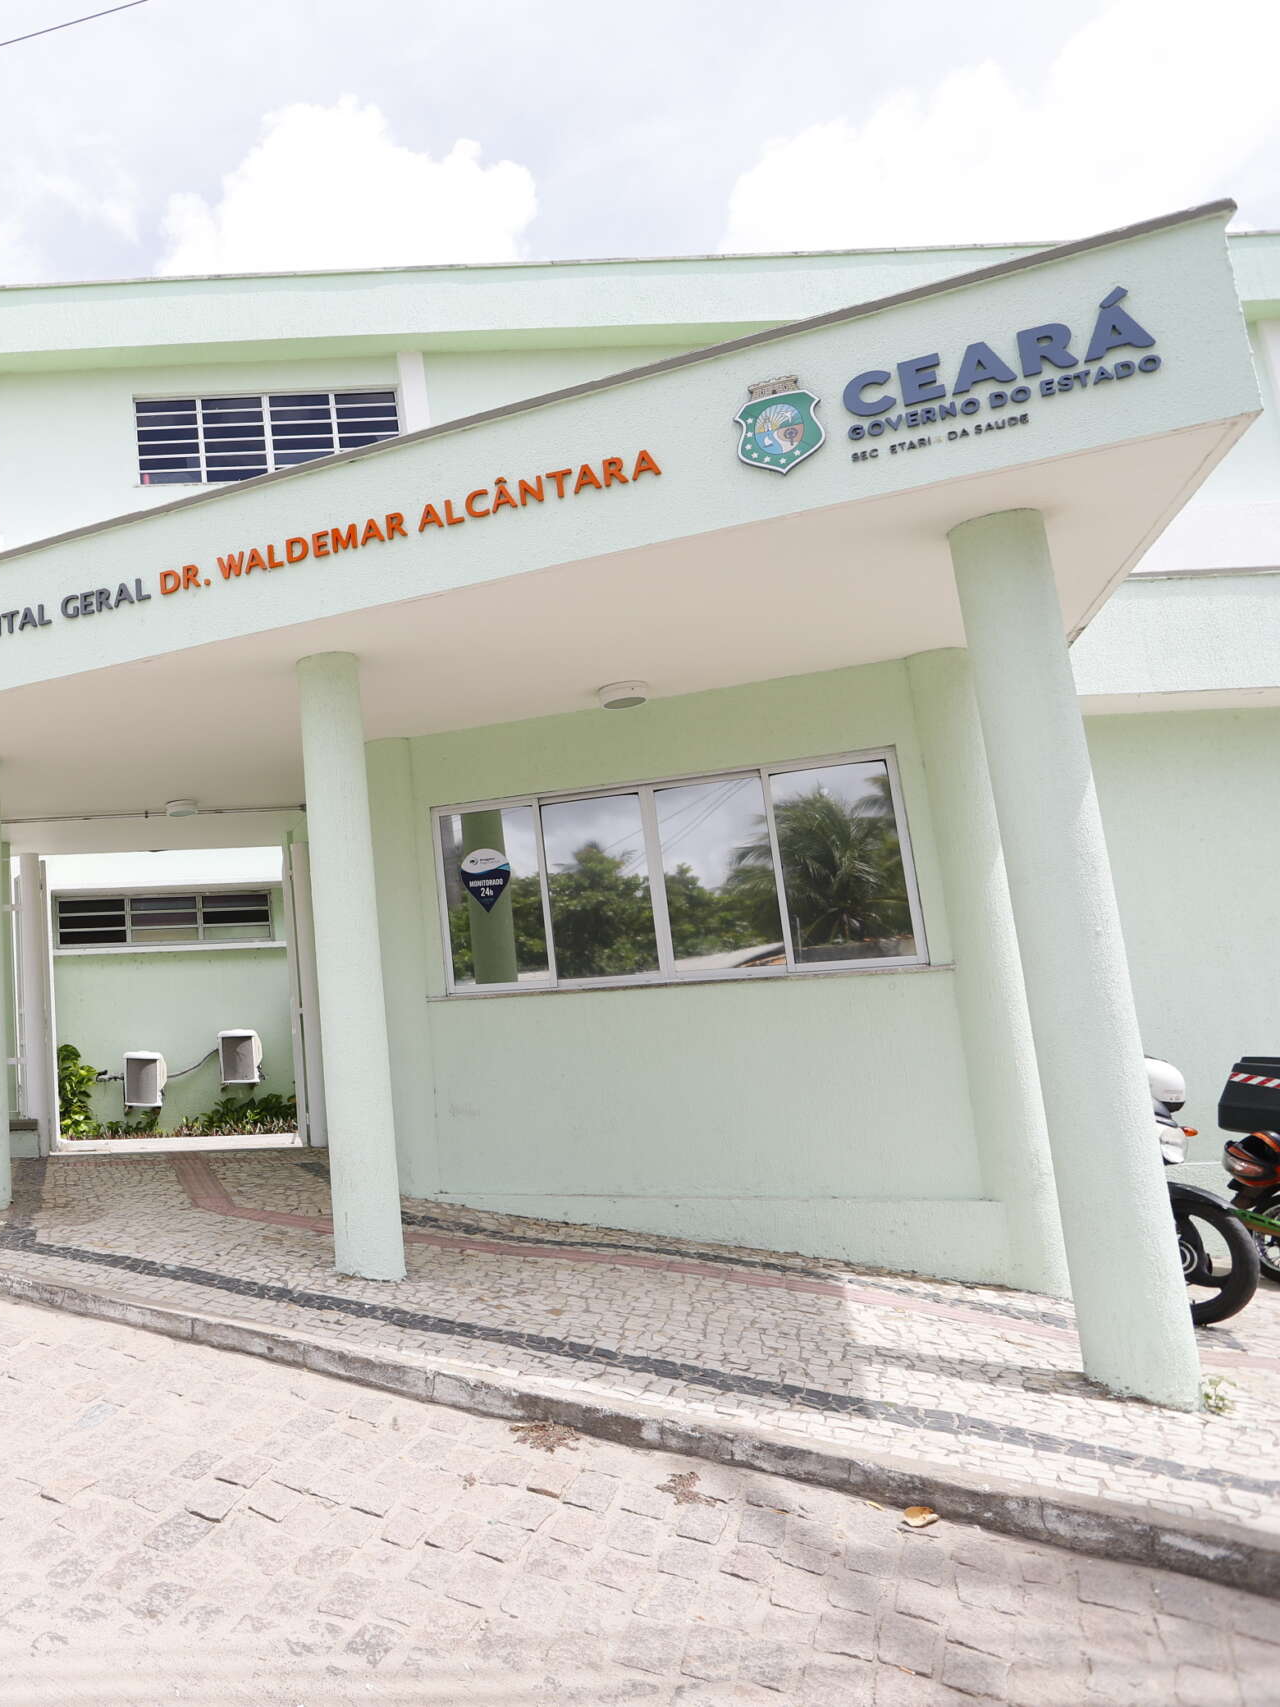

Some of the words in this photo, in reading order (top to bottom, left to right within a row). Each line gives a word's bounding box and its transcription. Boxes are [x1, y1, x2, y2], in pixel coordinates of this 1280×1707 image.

[842, 286, 1157, 418] CEARÁ
[848, 397, 981, 441] GOVERNO
[990, 385, 1032, 409] DO
[1039, 354, 1163, 397] ESTADO
[948, 428, 970, 442] DA
[60, 578, 151, 618] GERAL
[159, 564, 211, 596] DR.
[217, 512, 408, 579] WALDEMAR
[418, 449, 662, 532] ALCÂNTARA
[470, 878, 503, 887] MONITORADO
[480, 887, 493, 896] 24h
